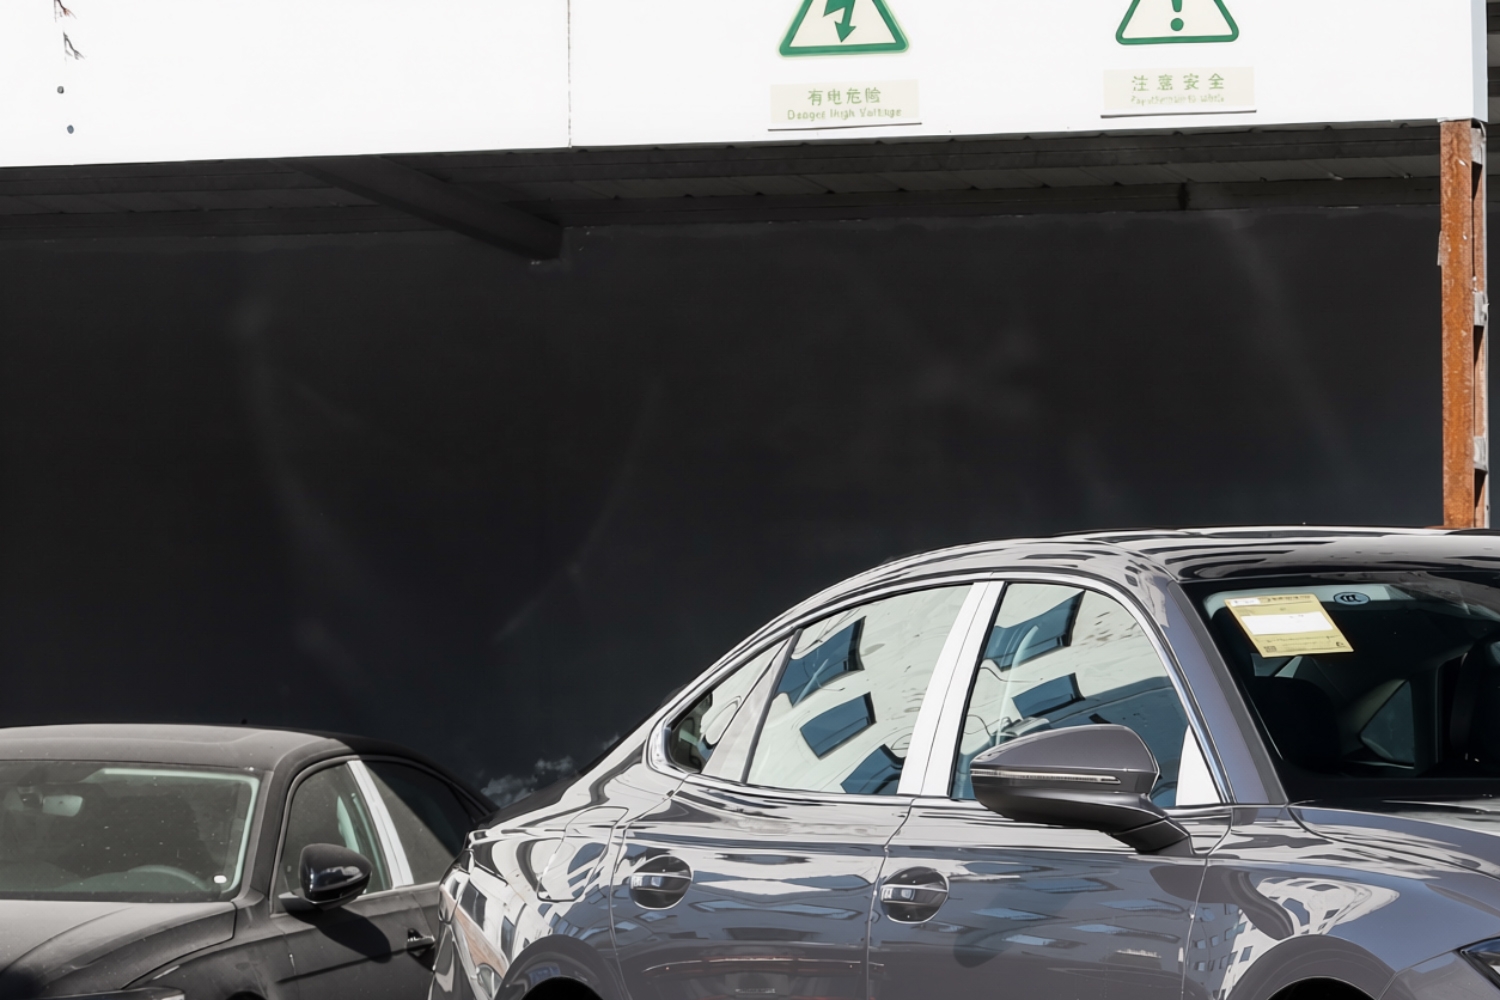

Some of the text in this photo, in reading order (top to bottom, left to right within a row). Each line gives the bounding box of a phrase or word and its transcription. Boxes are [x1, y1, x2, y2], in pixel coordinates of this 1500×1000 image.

[1131, 73, 1225, 91] 注意安全
[807, 87, 881, 106] 有电危险
